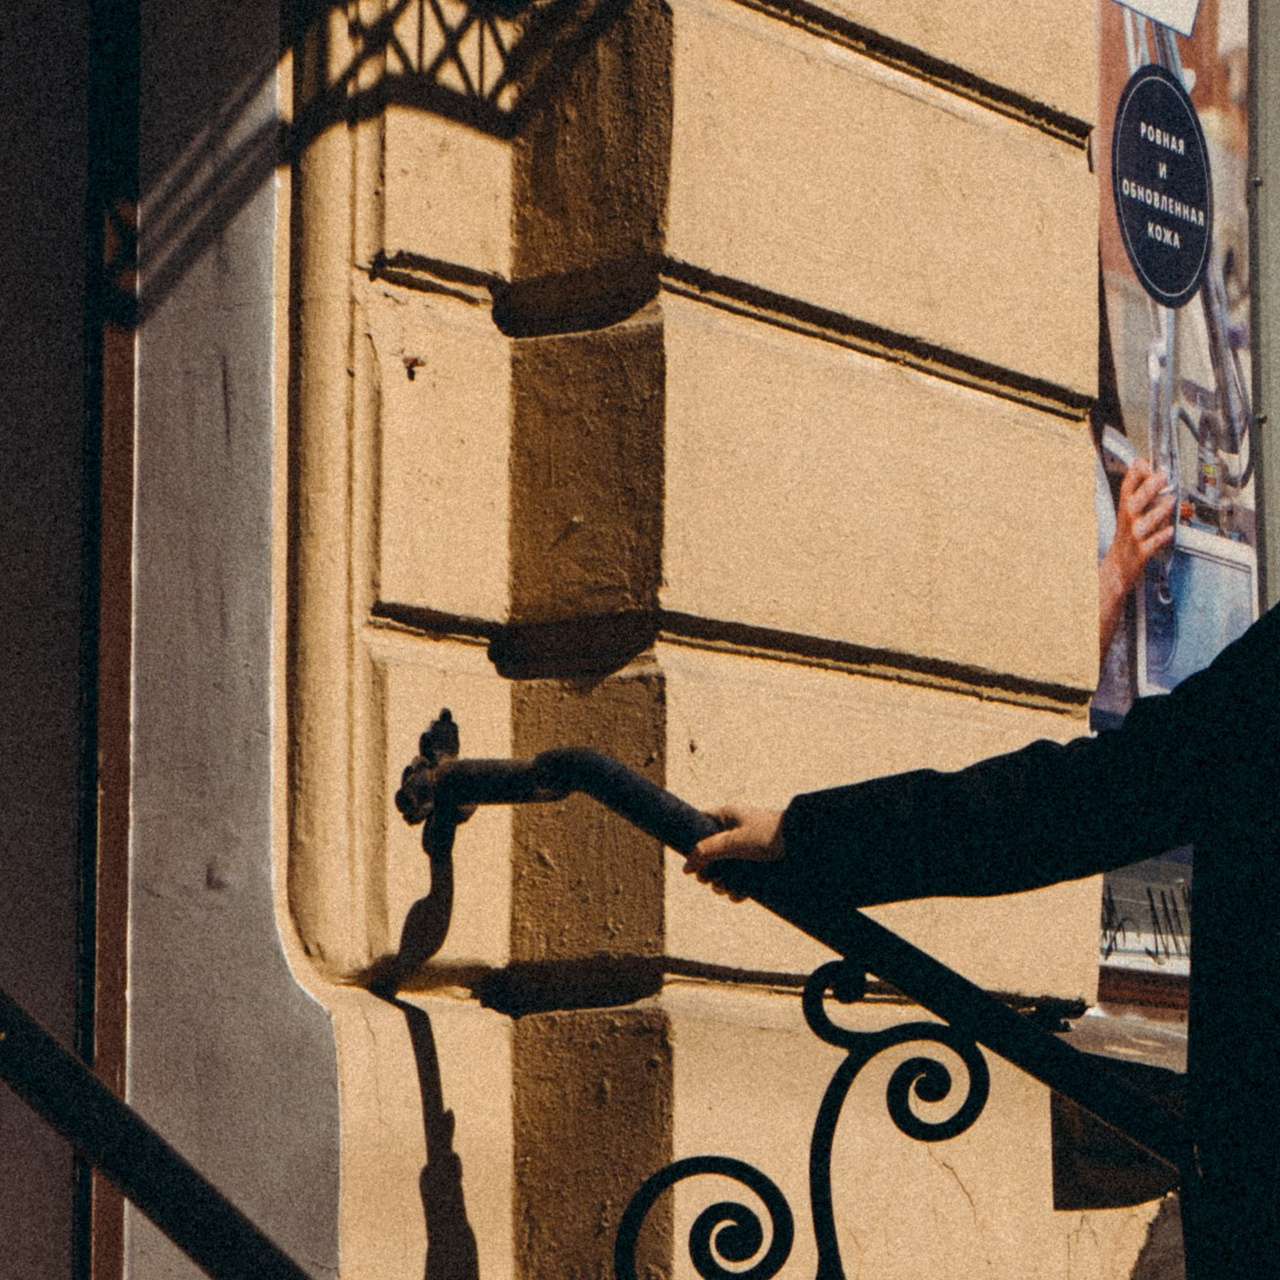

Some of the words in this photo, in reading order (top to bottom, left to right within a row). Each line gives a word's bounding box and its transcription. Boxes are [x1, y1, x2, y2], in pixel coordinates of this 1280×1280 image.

[1140, 121, 1185, 155] РОВНАЯ
[1159, 162, 1167, 179] И
[1122, 178, 1205, 226] ОБНОВЛЕННАЯ
[1147, 221, 1181, 249] КОЖА
